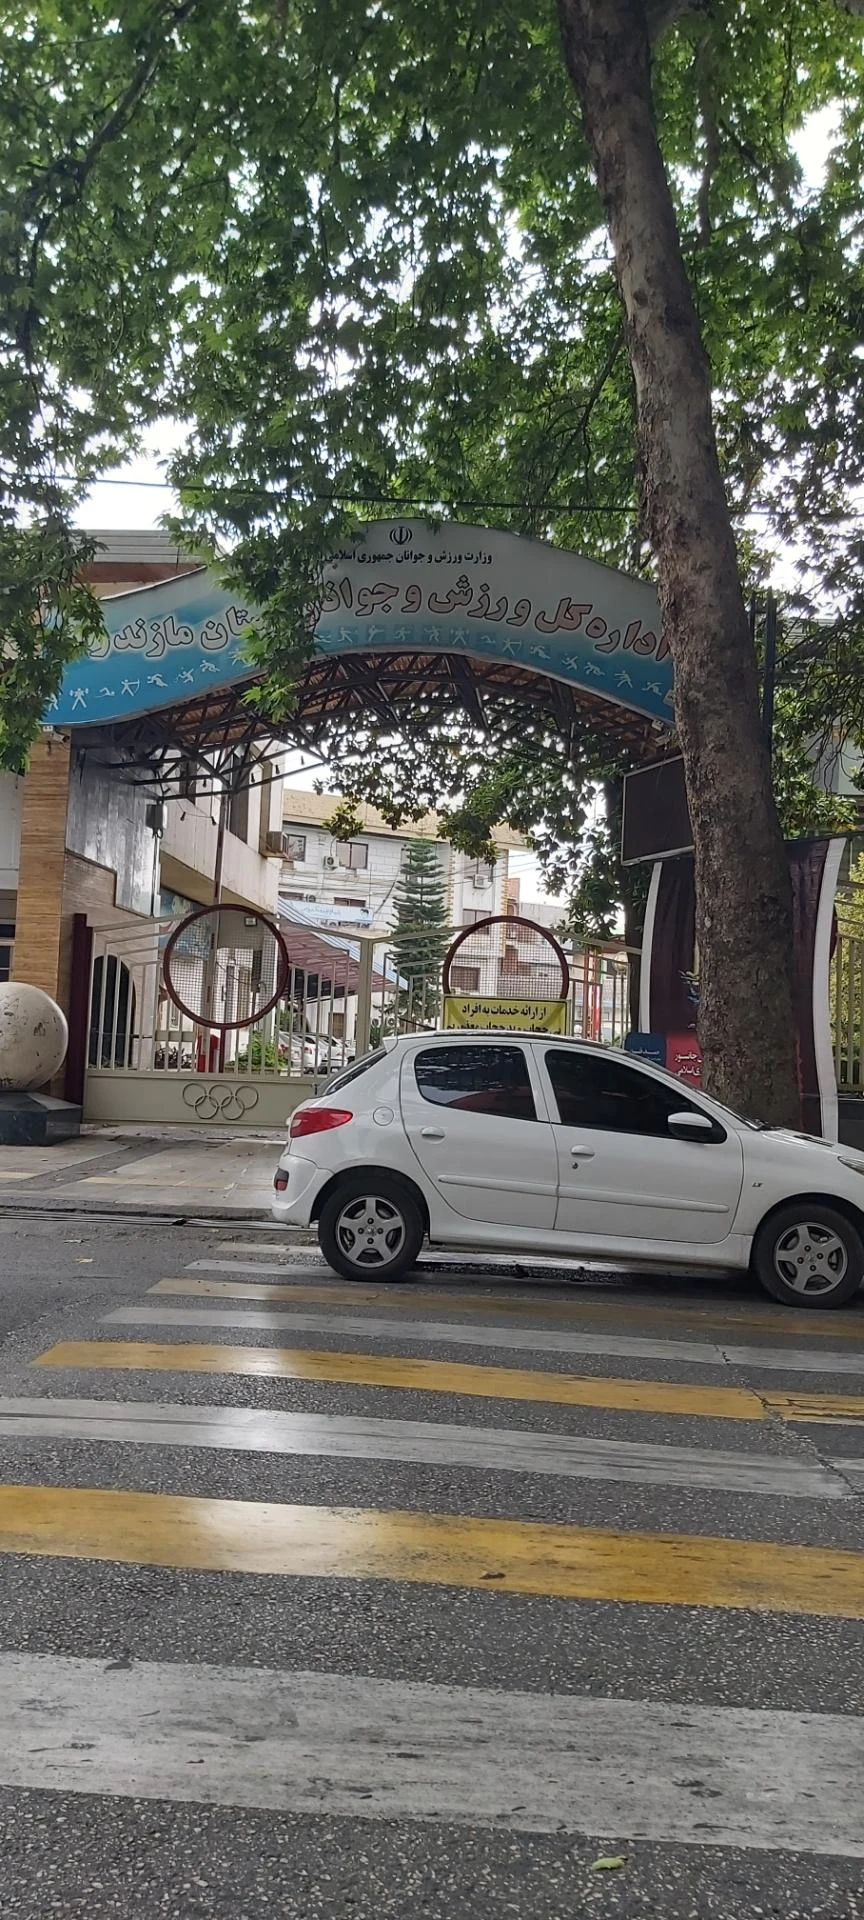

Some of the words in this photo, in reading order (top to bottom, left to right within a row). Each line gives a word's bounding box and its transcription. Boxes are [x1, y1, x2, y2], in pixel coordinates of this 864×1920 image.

[357, 552, 394, 564] جمهوری
[395, 550, 425, 565] جوانان
[427, 553, 433, 565] و
[434, 550, 463, 565] ورزش
[464, 550, 493, 565] وزارت
[401, 584, 423, 613] و
[427, 574, 532, 627] ورزش
[535, 597, 593, 633] کل
[462, 1002, 482, 1017] افراد
[482, 1006, 490, 1017] به
[490, 1004, 520, 1015] خدمات
[520, 1004, 539, 1020] ارائه
[539, 1006, 547, 1021] از
